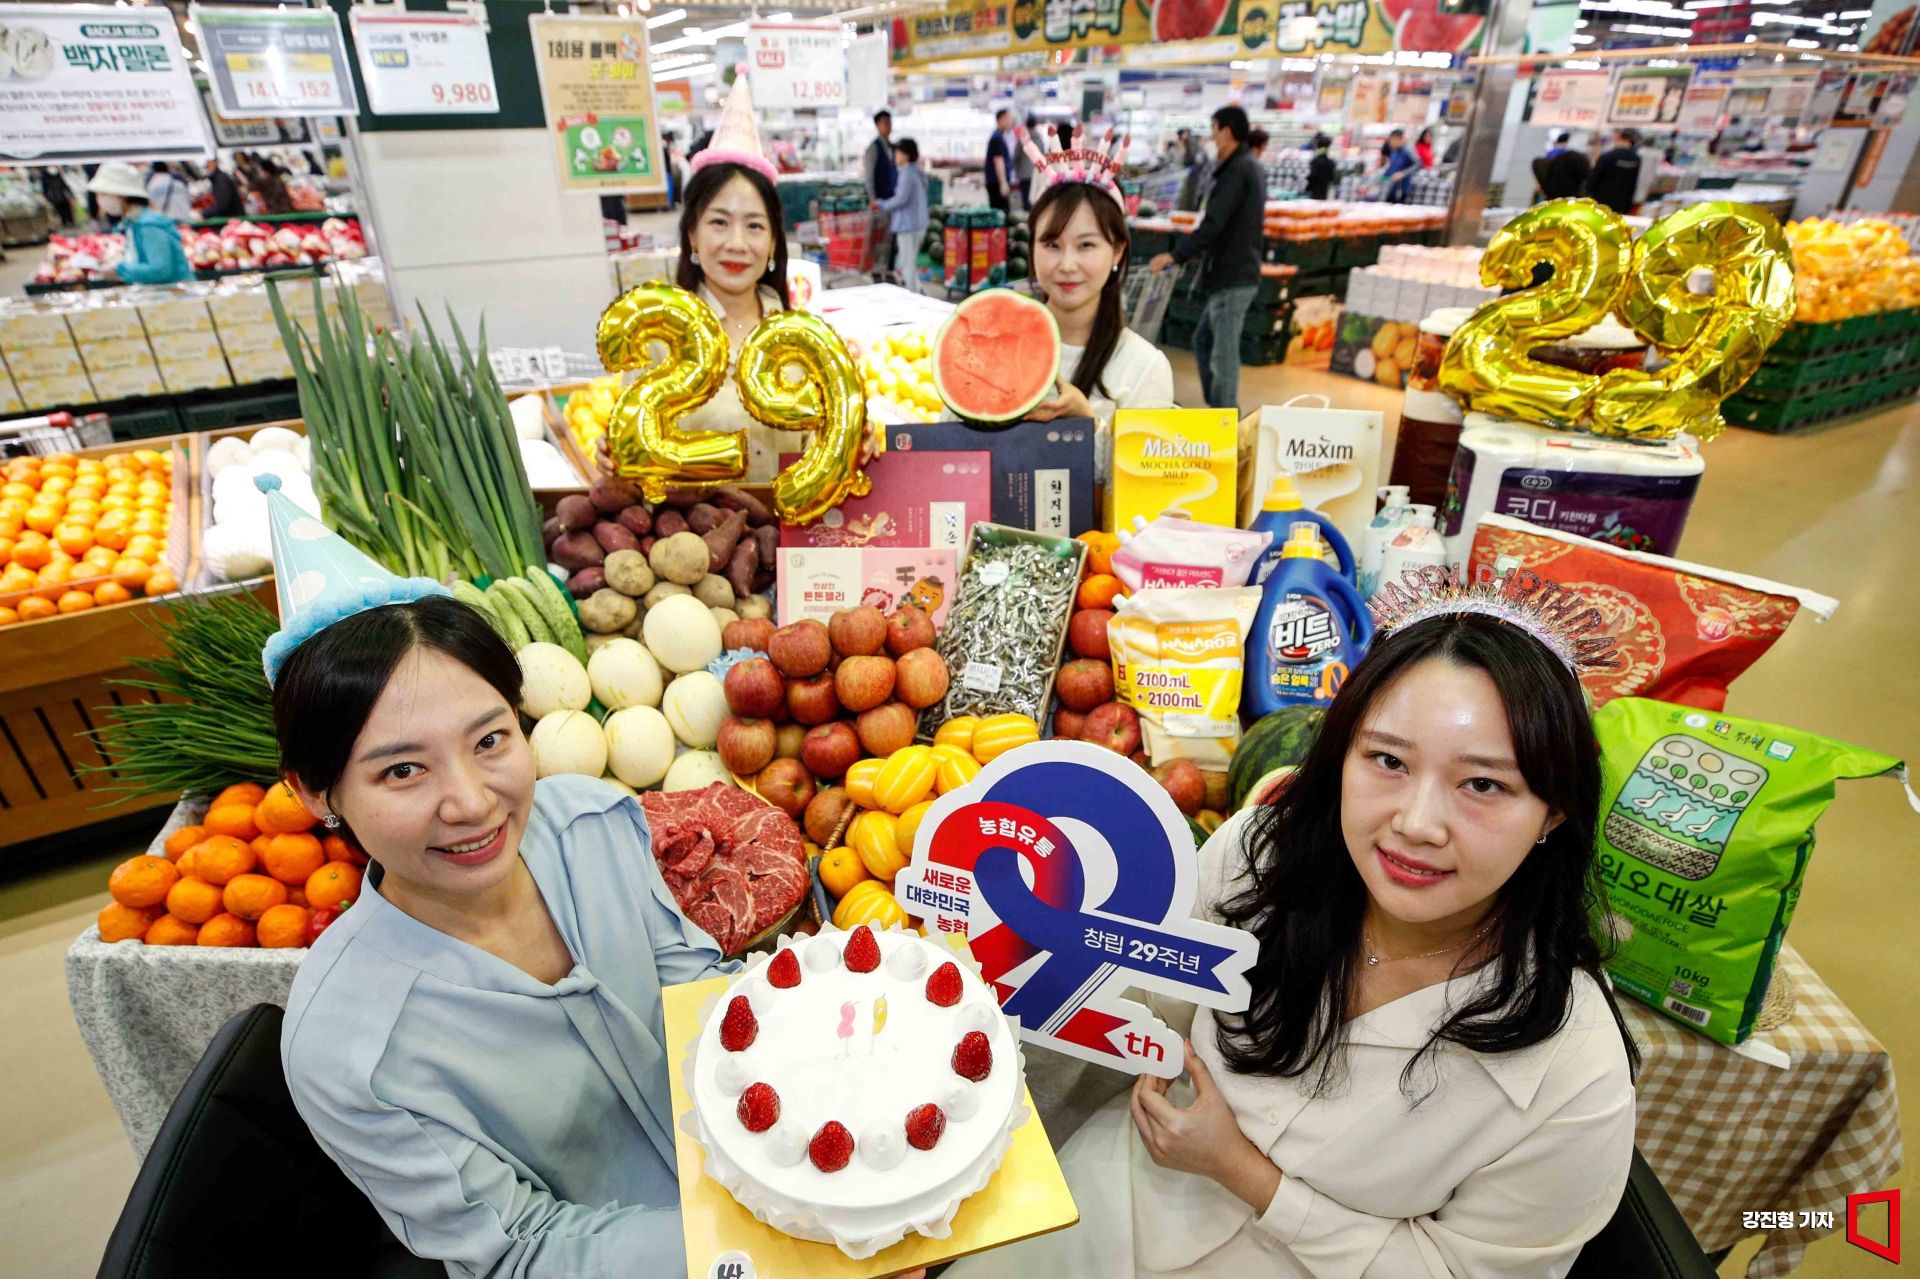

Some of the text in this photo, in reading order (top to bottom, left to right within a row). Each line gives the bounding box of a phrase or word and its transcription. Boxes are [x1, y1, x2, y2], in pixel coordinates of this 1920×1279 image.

[62, 44, 172, 72] 백자멜론
[431, 83, 491, 105] 9,980
[597, 280, 868, 526] 29
[1142, 435, 1211, 458] Maxim
[1285, 435, 1354, 460] Maxim
[1140, 461, 1212, 470] MOCHA GOLD
[1162, 471, 1189, 479] MILD
[1506, 496, 1557, 520] 코디
[1560, 511, 1597, 525] 키친타월
[804, 592, 845, 602] 튼튼젤리
[1306, 635, 1341, 660] ZERO
[1136, 672, 1191, 689] 2100mL
[1148, 692, 1203, 709] 2100mL
[978, 816, 1056, 858] 농협유통
[922, 868, 971, 895] 새로운
[906, 884, 970, 917] 대한민국
[1083, 927, 1201, 975] 창립 29주년
[1674, 965, 1710, 988] 10kg
[1124, 1031, 1164, 1062] th
